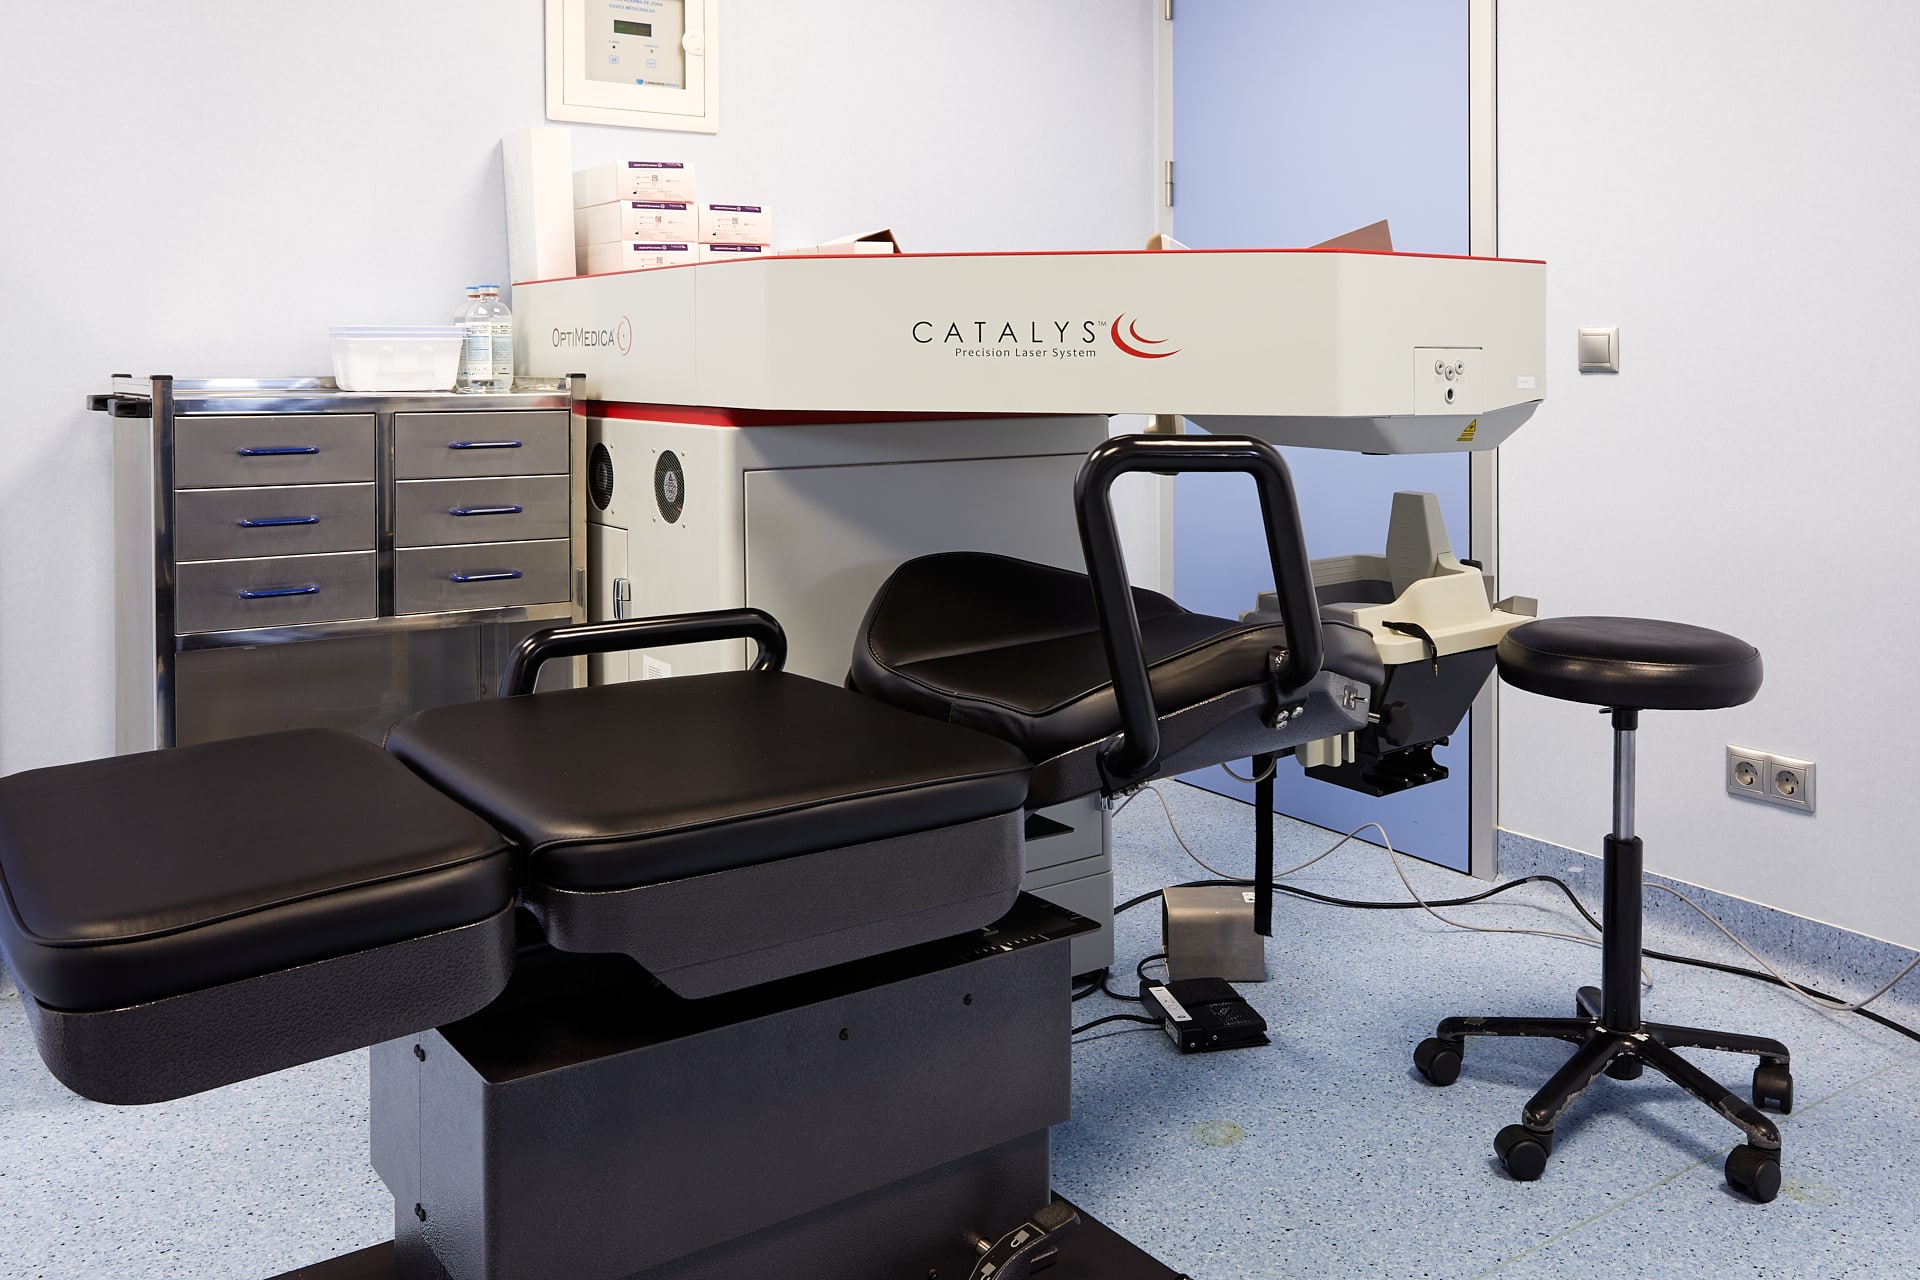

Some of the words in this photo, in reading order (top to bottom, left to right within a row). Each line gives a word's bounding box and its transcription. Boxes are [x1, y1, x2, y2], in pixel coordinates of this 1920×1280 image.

[955, 347, 1010, 357] Precision
[1015, 347, 1048, 357] Laser
[1052, 347, 1096, 360] System
